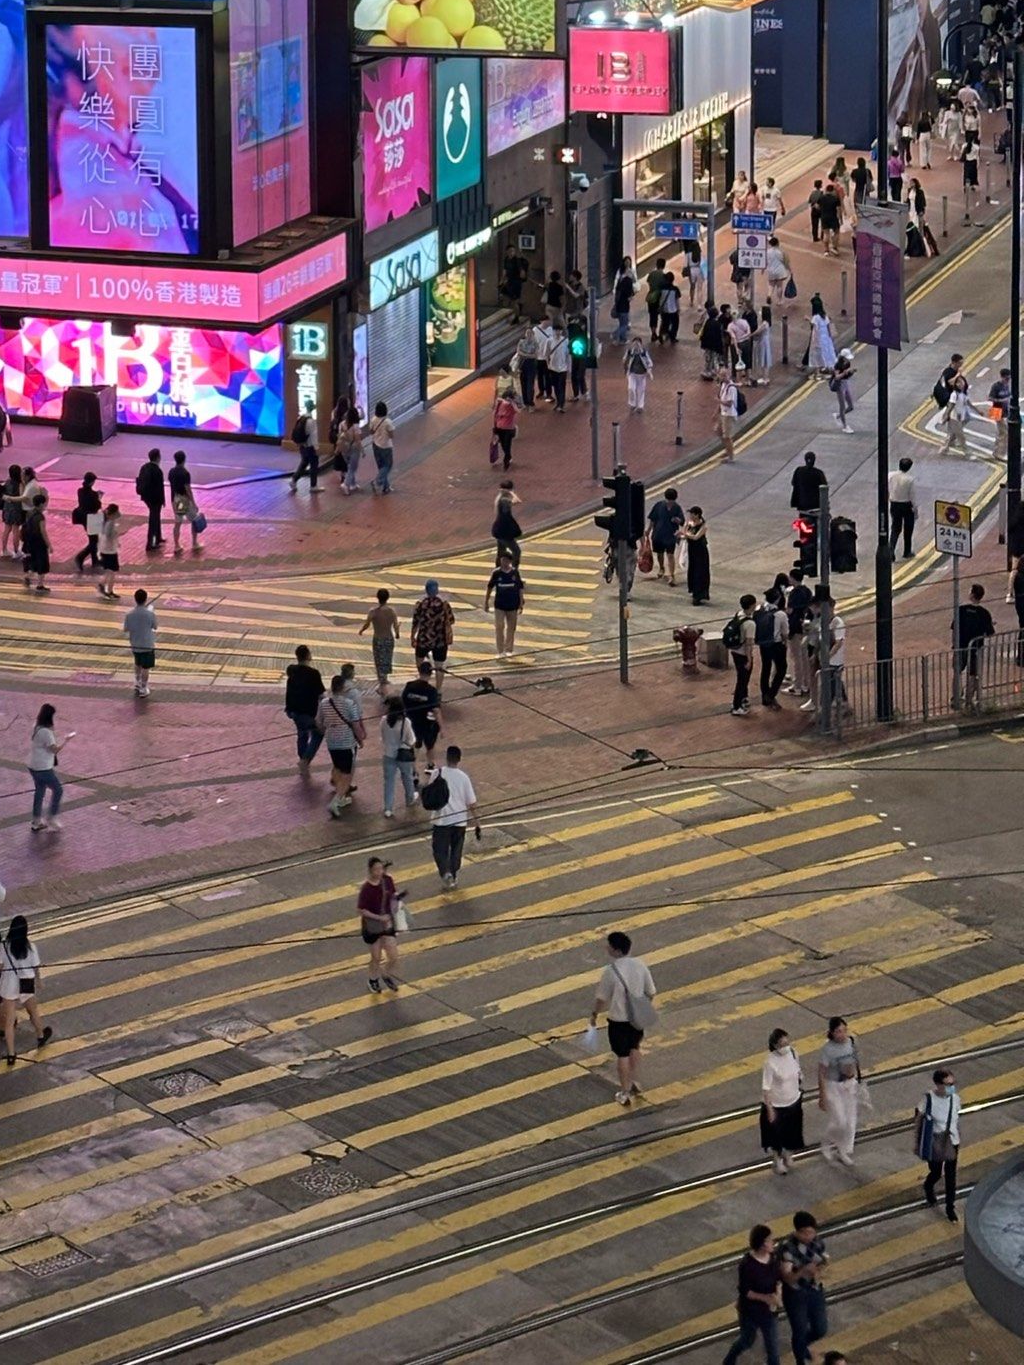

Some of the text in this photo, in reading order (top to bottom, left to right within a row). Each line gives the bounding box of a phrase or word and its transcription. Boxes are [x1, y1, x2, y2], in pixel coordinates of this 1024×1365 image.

[76, 40, 117, 234] 快樂從心
[128, 44, 168, 235] 團圓有心
[89, 277, 243, 307] 100%香港製造
[940, 527, 951, 537] 24
[943, 539, 964, 552] 全日
